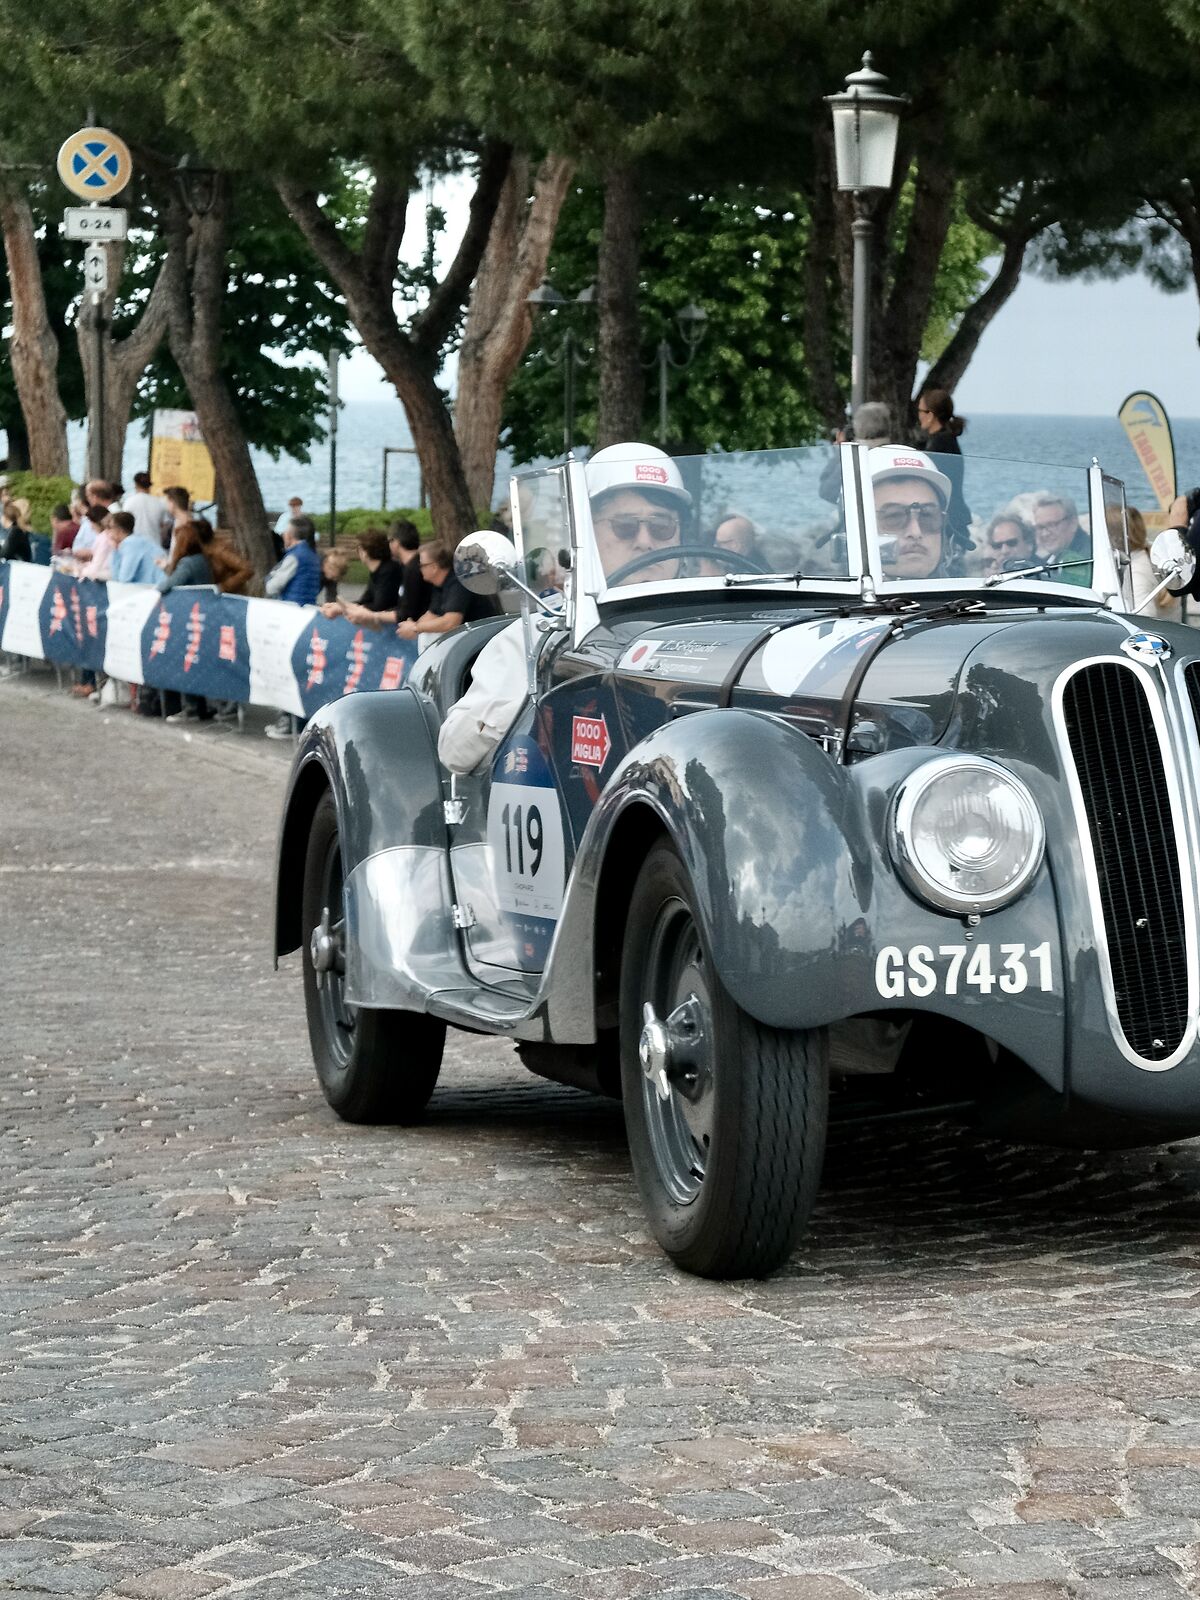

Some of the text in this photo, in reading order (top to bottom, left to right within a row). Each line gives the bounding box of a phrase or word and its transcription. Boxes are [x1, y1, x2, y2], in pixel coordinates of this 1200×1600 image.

[638, 466, 661, 474] 1000
[576, 722, 601, 741] 1000
[573, 742, 602, 760] MIGLIA
[501, 803, 543, 877] 119
[875, 941, 1053, 999] GS7431
